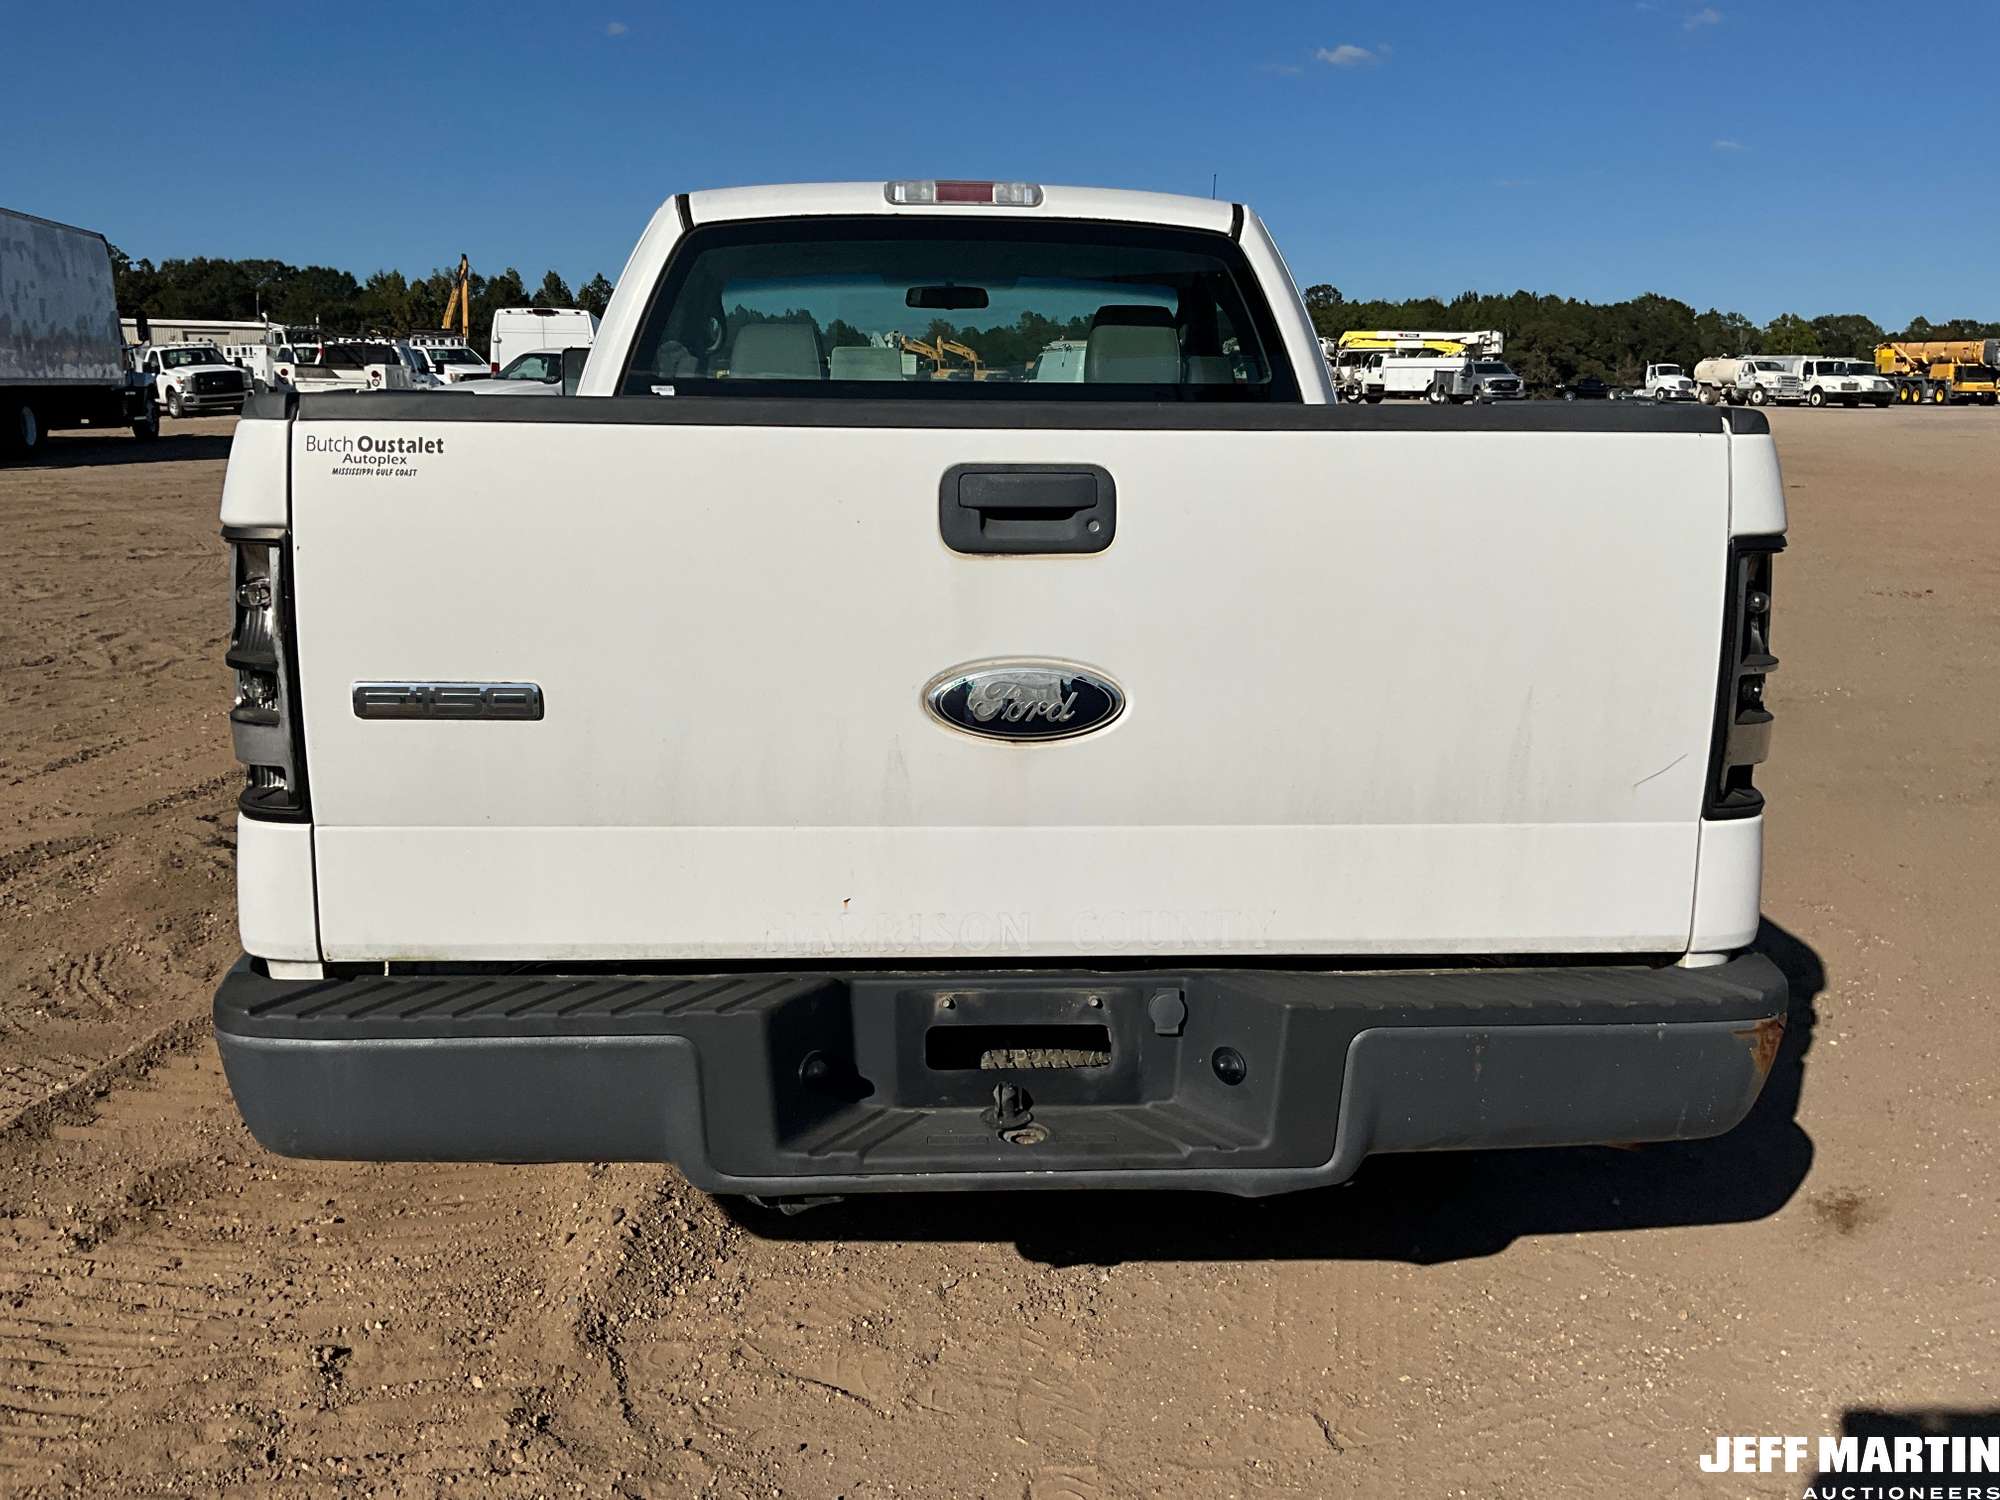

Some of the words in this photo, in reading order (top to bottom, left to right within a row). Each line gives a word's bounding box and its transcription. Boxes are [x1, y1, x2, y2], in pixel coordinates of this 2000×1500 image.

[306, 435, 354, 453] Butch
[357, 435, 444, 454] Oustalet
[342, 453, 408, 467] Autoplex
[332, 467, 374, 476] MISSISSIPPI
[375, 468, 394, 477] GULF
[395, 468, 418, 477] COAST
[971, 680, 1079, 723] Ford
[1072, 909, 1278, 951] COUNTY
